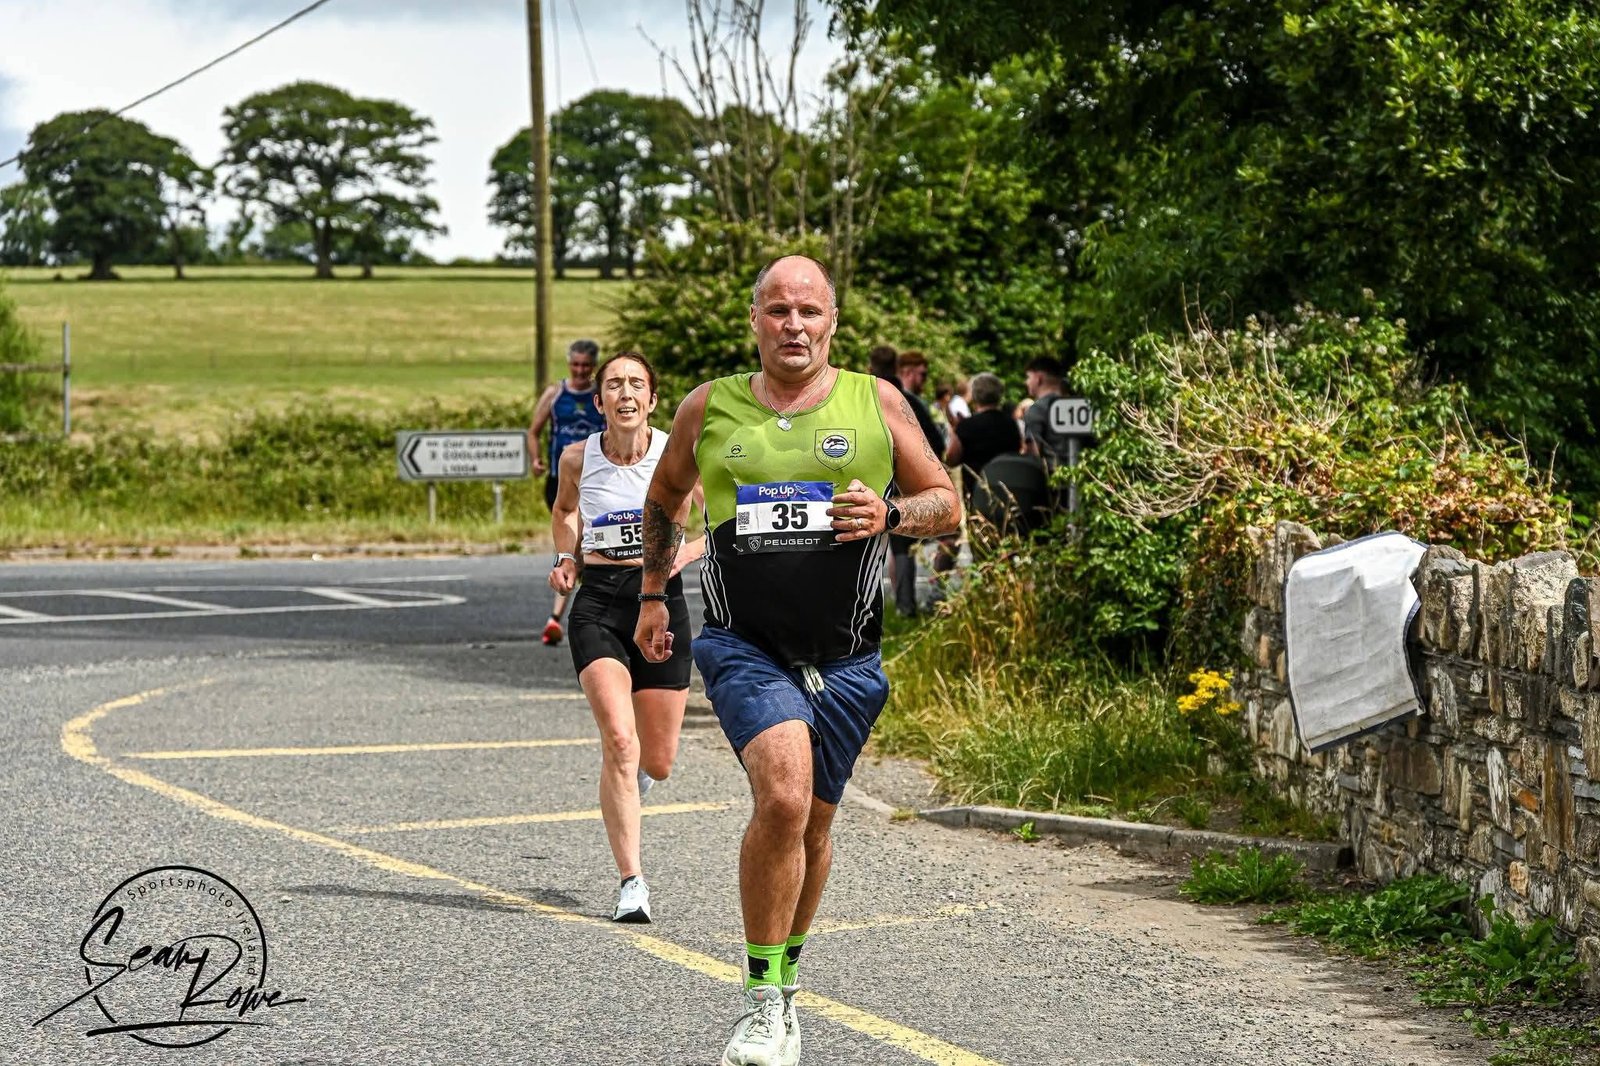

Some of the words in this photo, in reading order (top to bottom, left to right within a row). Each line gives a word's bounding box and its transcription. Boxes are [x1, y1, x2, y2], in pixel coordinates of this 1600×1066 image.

[1055, 406, 1095, 426] L10
[758, 486, 778, 498] Pop
[780, 485, 795, 497] Up
[607, 513, 623, 521] Pop
[623, 512, 635, 521] Up
[771, 503, 809, 530] 35
[620, 524, 643, 544] 55
[764, 538, 821, 546] PEUGEOT
